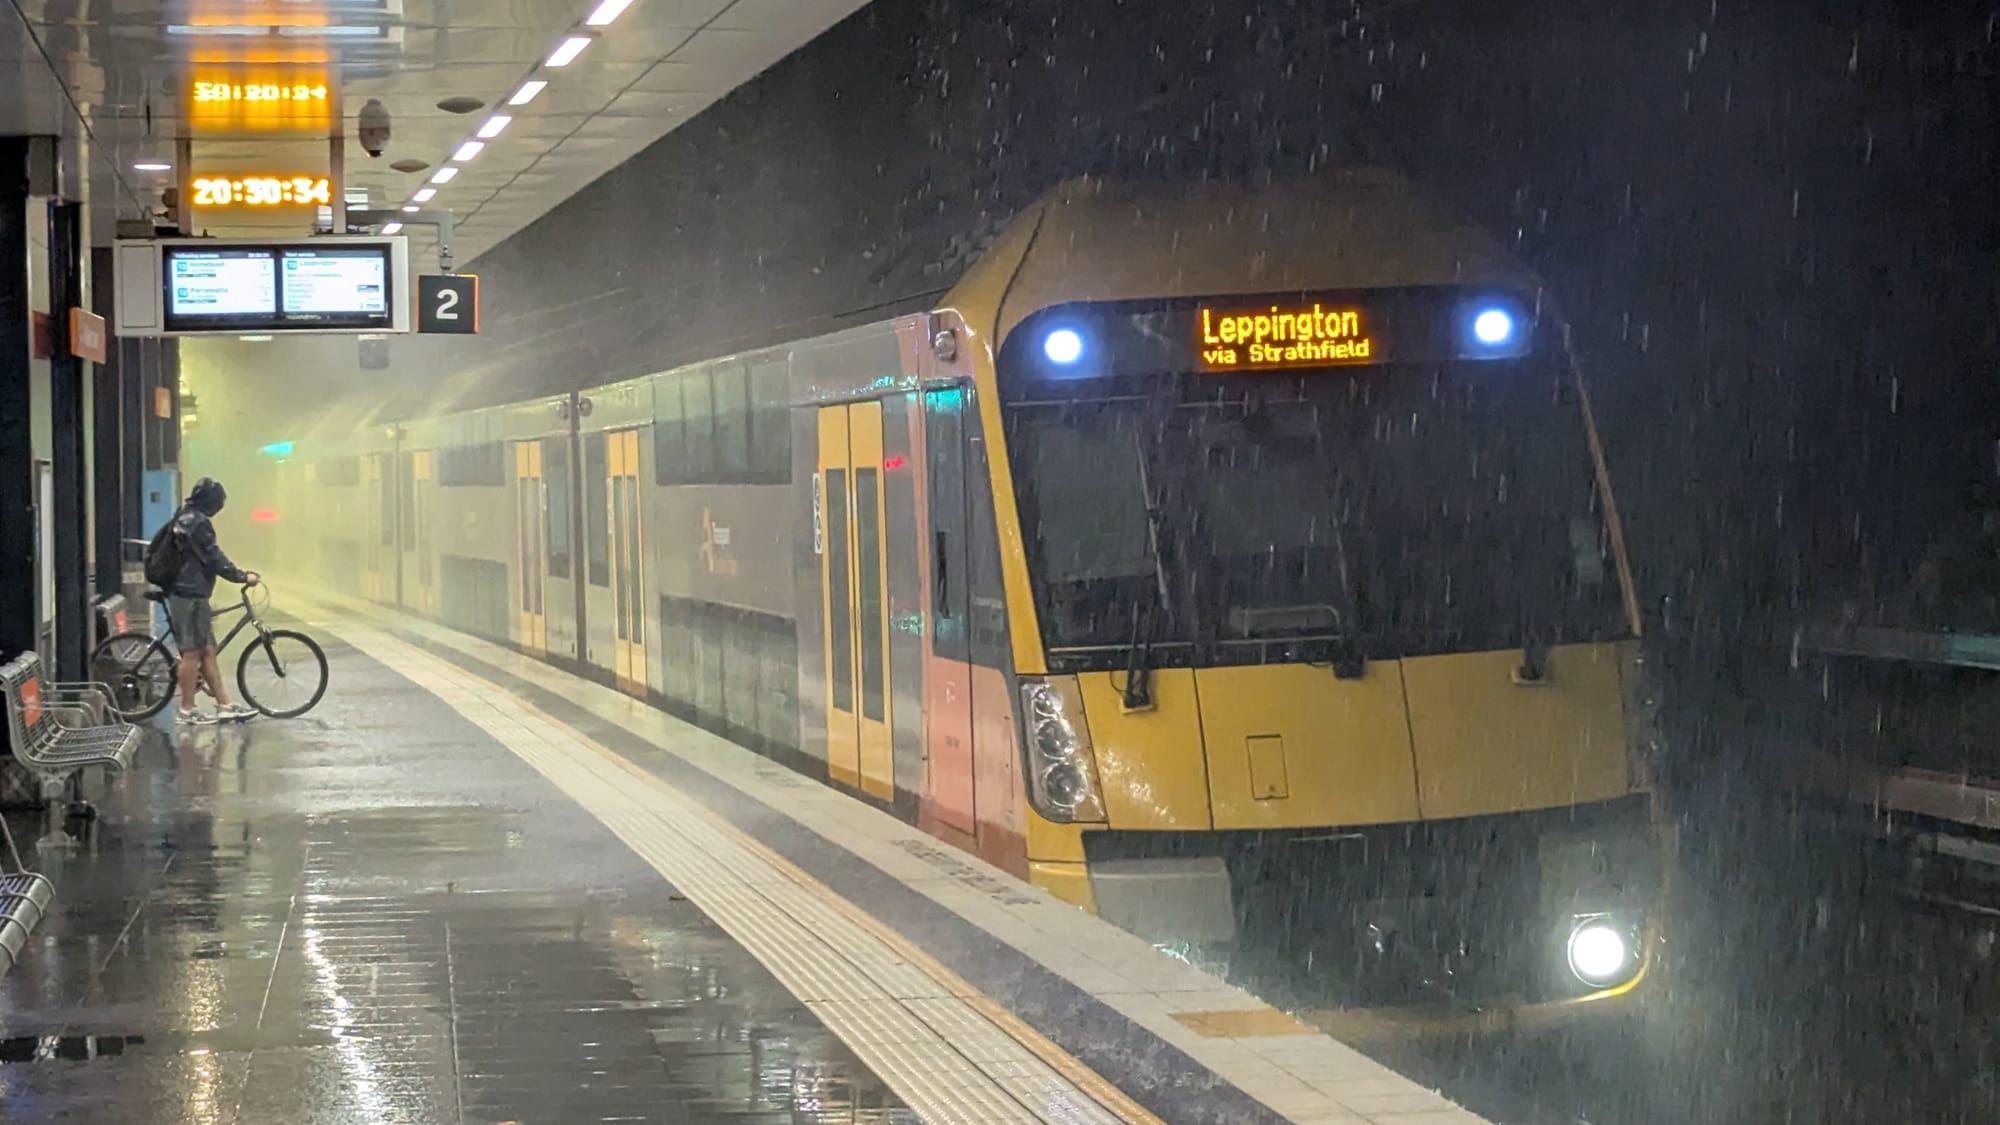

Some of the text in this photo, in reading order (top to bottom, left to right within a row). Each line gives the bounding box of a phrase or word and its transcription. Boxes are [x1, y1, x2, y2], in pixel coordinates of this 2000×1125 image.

[192, 177, 331, 205] 20:30:34
[436, 288, 459, 320] 2
[1202, 303, 1359, 345] Leppington
[1202, 338, 1371, 365] via Strathfield
